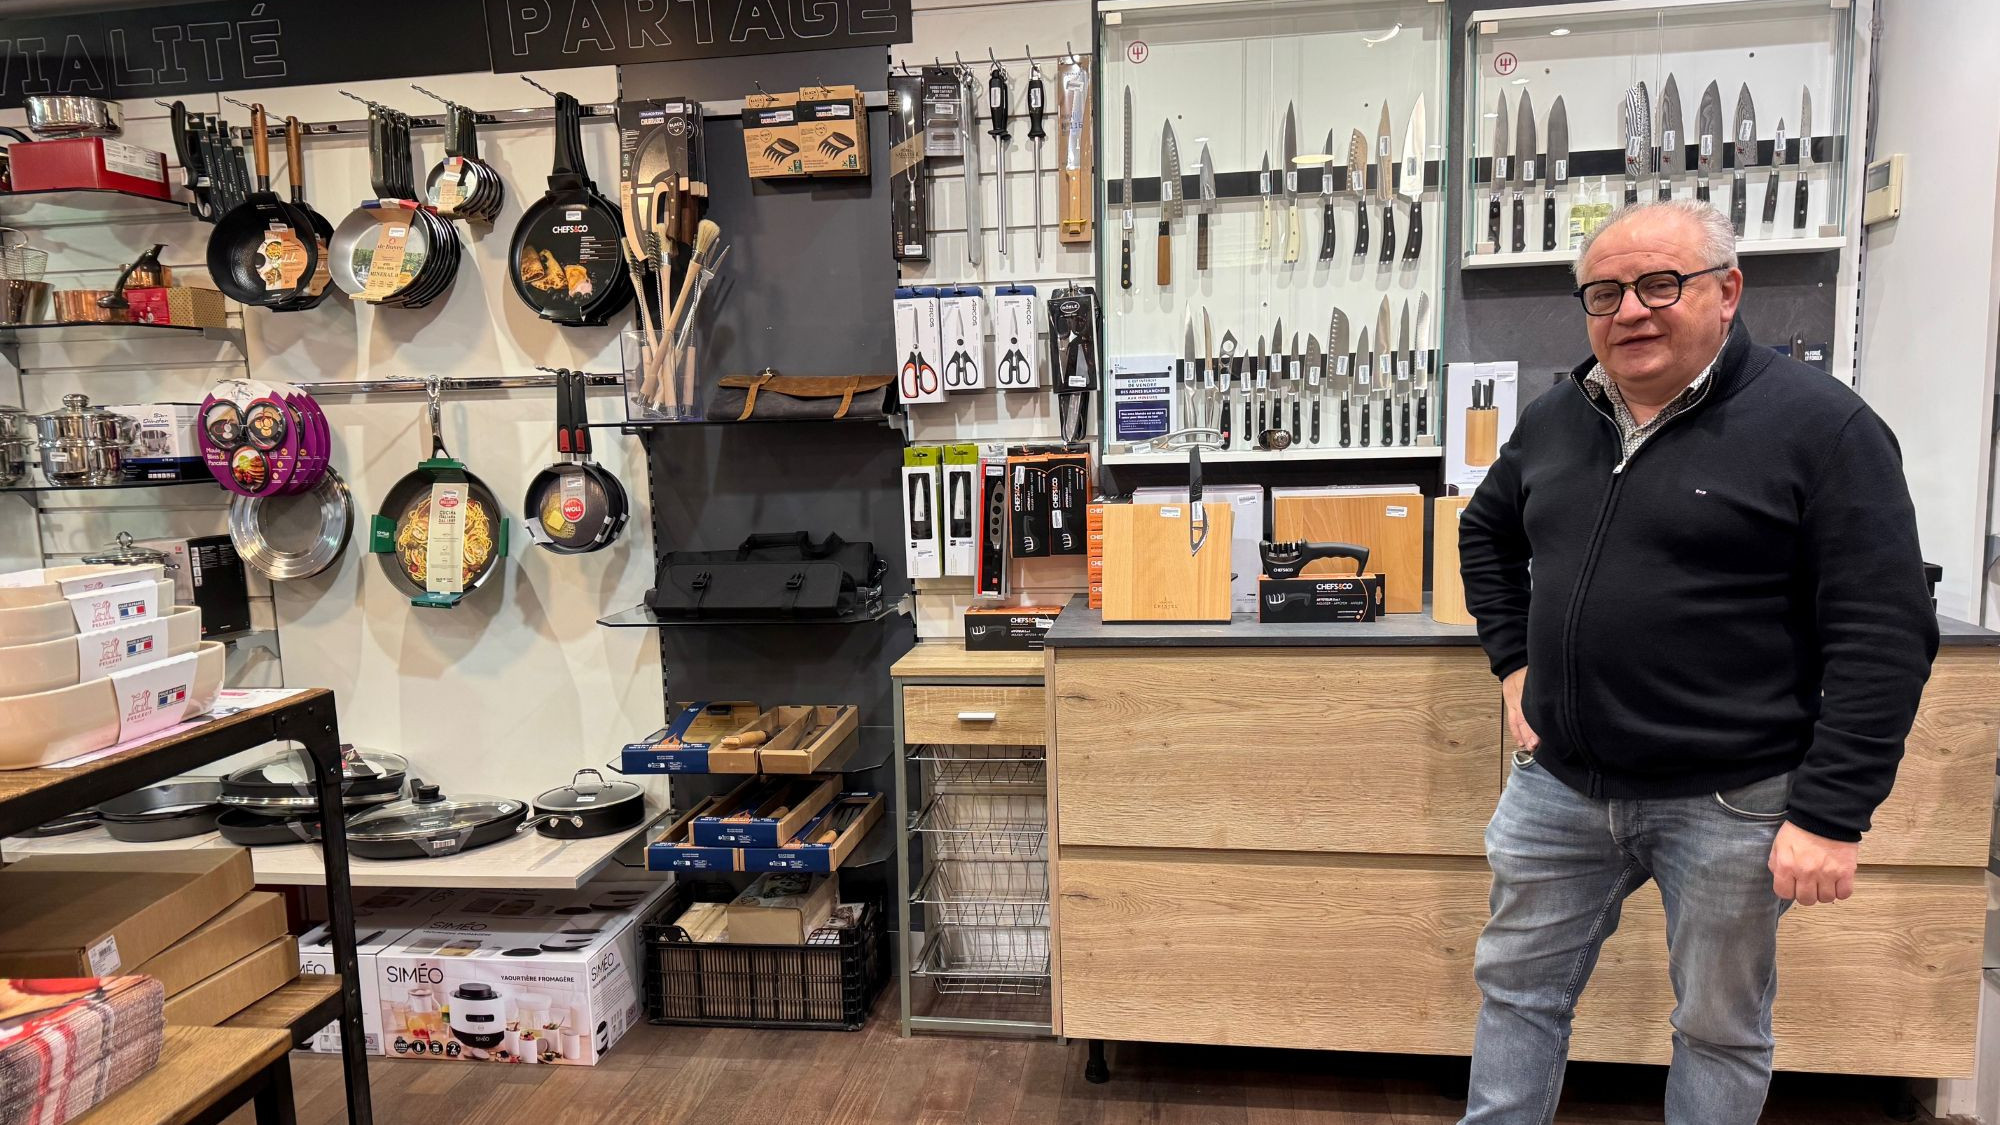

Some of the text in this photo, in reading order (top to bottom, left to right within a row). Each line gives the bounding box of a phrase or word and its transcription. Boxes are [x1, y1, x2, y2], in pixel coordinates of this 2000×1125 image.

[506, 0, 898, 55] PARTAGE
[0, 3, 287, 97] IALITÉ
[552, 224, 588, 234] CHEFS&CO
[1316, 582, 1353, 590] CHEFS&CO
[430, 921, 488, 931] SIMÉO
[386, 963, 444, 984] SIMÉO
[591, 952, 615, 982] SIMÉO
[501, 974, 575, 983] YAOURTIÈRE FROMAGÈRE
